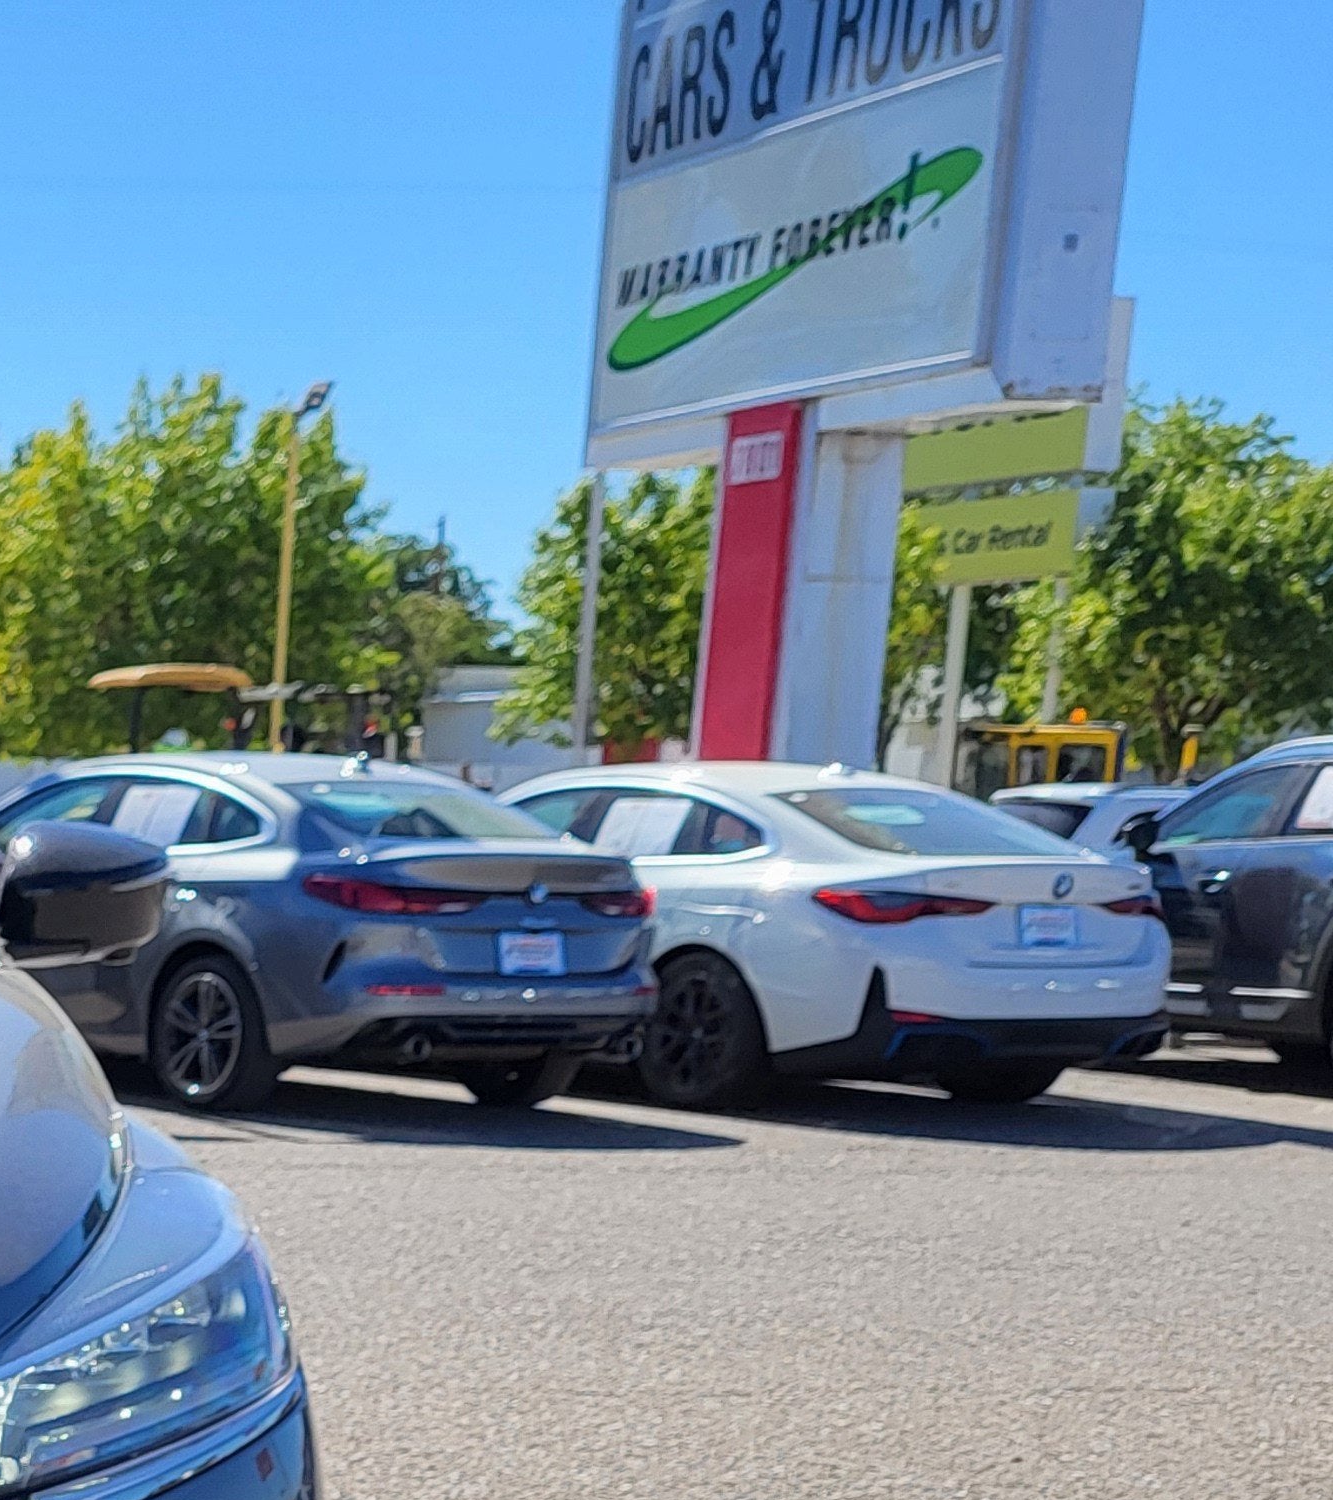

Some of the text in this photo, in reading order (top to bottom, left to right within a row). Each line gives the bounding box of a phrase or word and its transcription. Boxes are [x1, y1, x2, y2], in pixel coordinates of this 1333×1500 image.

[626, 9, 736, 164] CARS
[749, 0, 786, 121] &
[616, 235, 762, 308] WARRANTY
